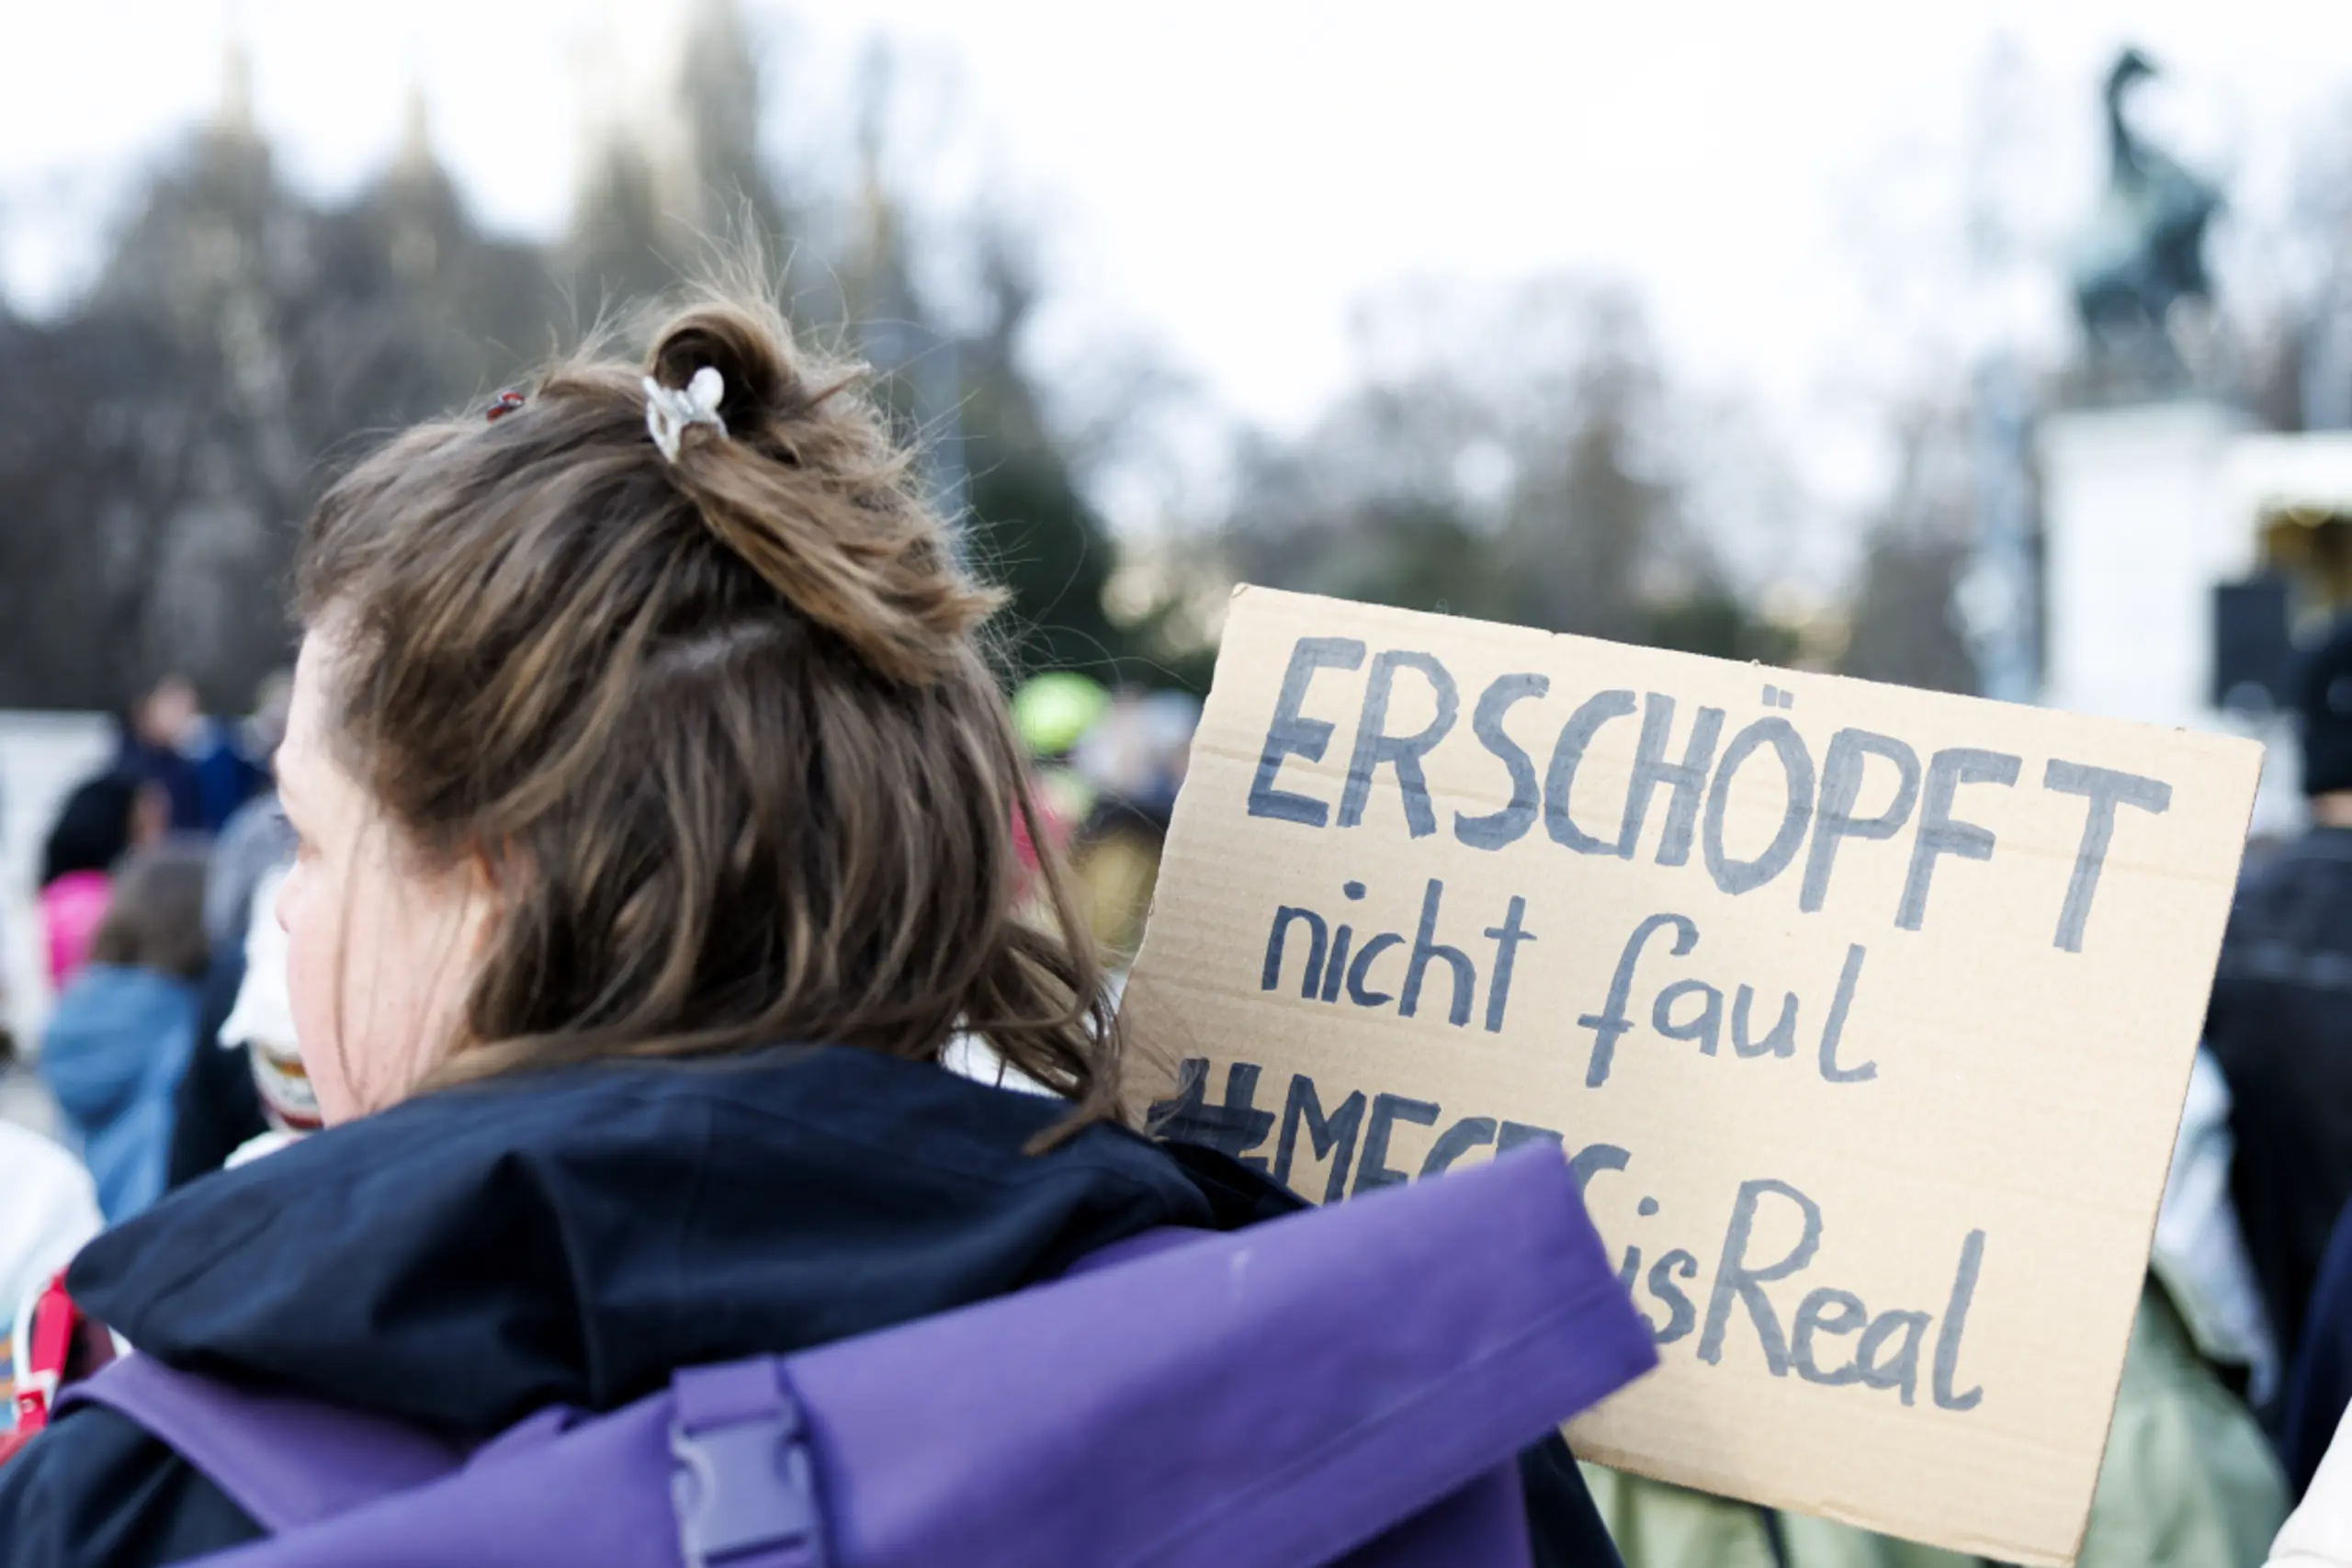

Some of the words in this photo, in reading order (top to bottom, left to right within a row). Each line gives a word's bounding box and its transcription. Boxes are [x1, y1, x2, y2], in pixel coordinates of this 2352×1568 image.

[1247, 637, 2172, 953] ERSCHÖPFT
[1261, 878, 1537, 1032] nicht
[1577, 912, 1878, 1089] faul
